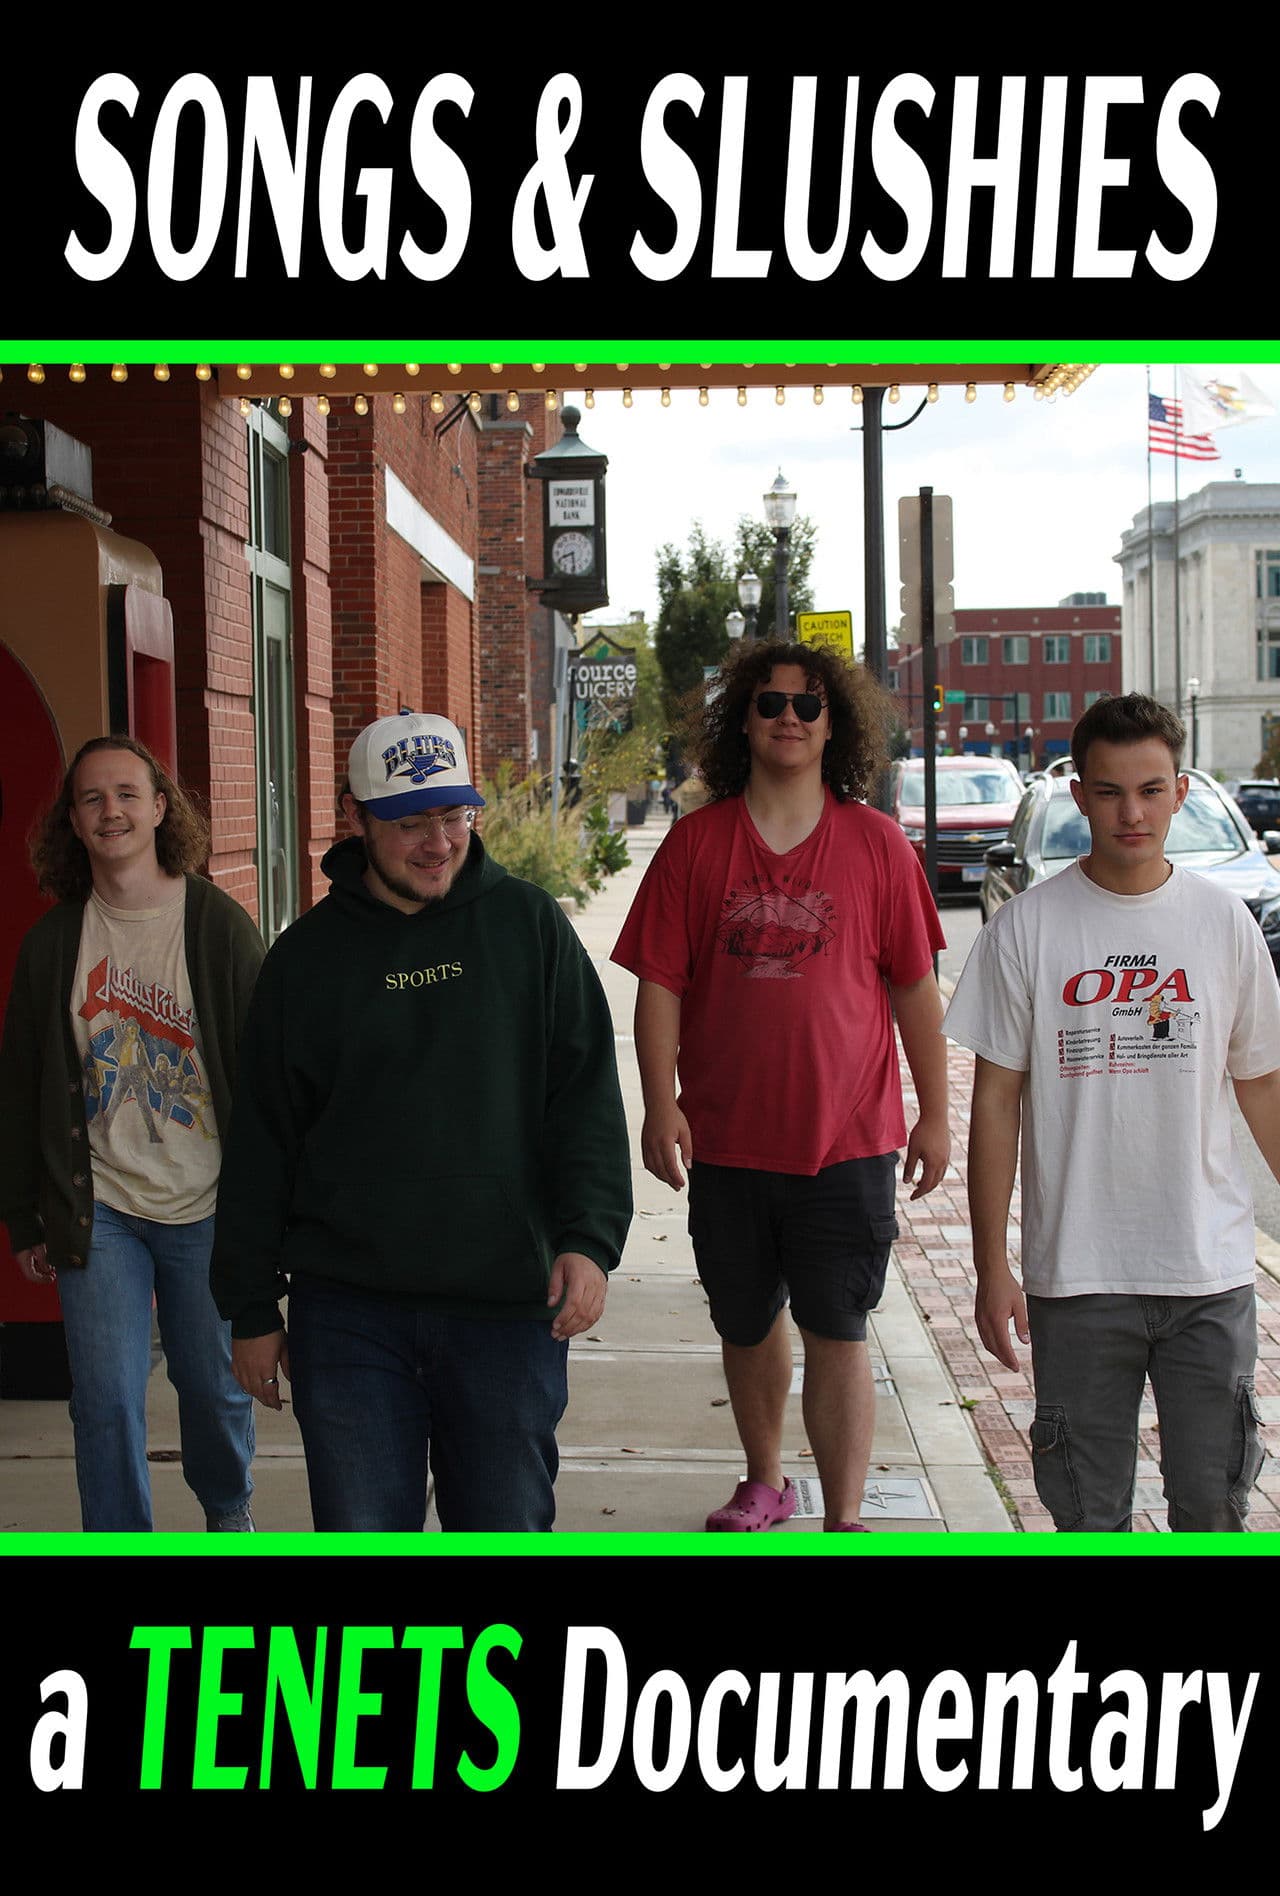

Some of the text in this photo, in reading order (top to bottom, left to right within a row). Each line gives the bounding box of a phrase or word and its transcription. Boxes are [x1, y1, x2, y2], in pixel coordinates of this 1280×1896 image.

[555, 499, 587, 508] NATIONAL
[563, 511, 581, 520] BANK
[803, 620, 848, 631] CAUTION
[575, 680, 637, 699] UICERY
[382, 735, 457, 782] BLUES
[1104, 954, 1157, 968] FIRMA
[385, 961, 463, 990] SPORTS
[1062, 968, 1195, 1007] OPA
[1112, 1006, 1142, 1017] GmbH
